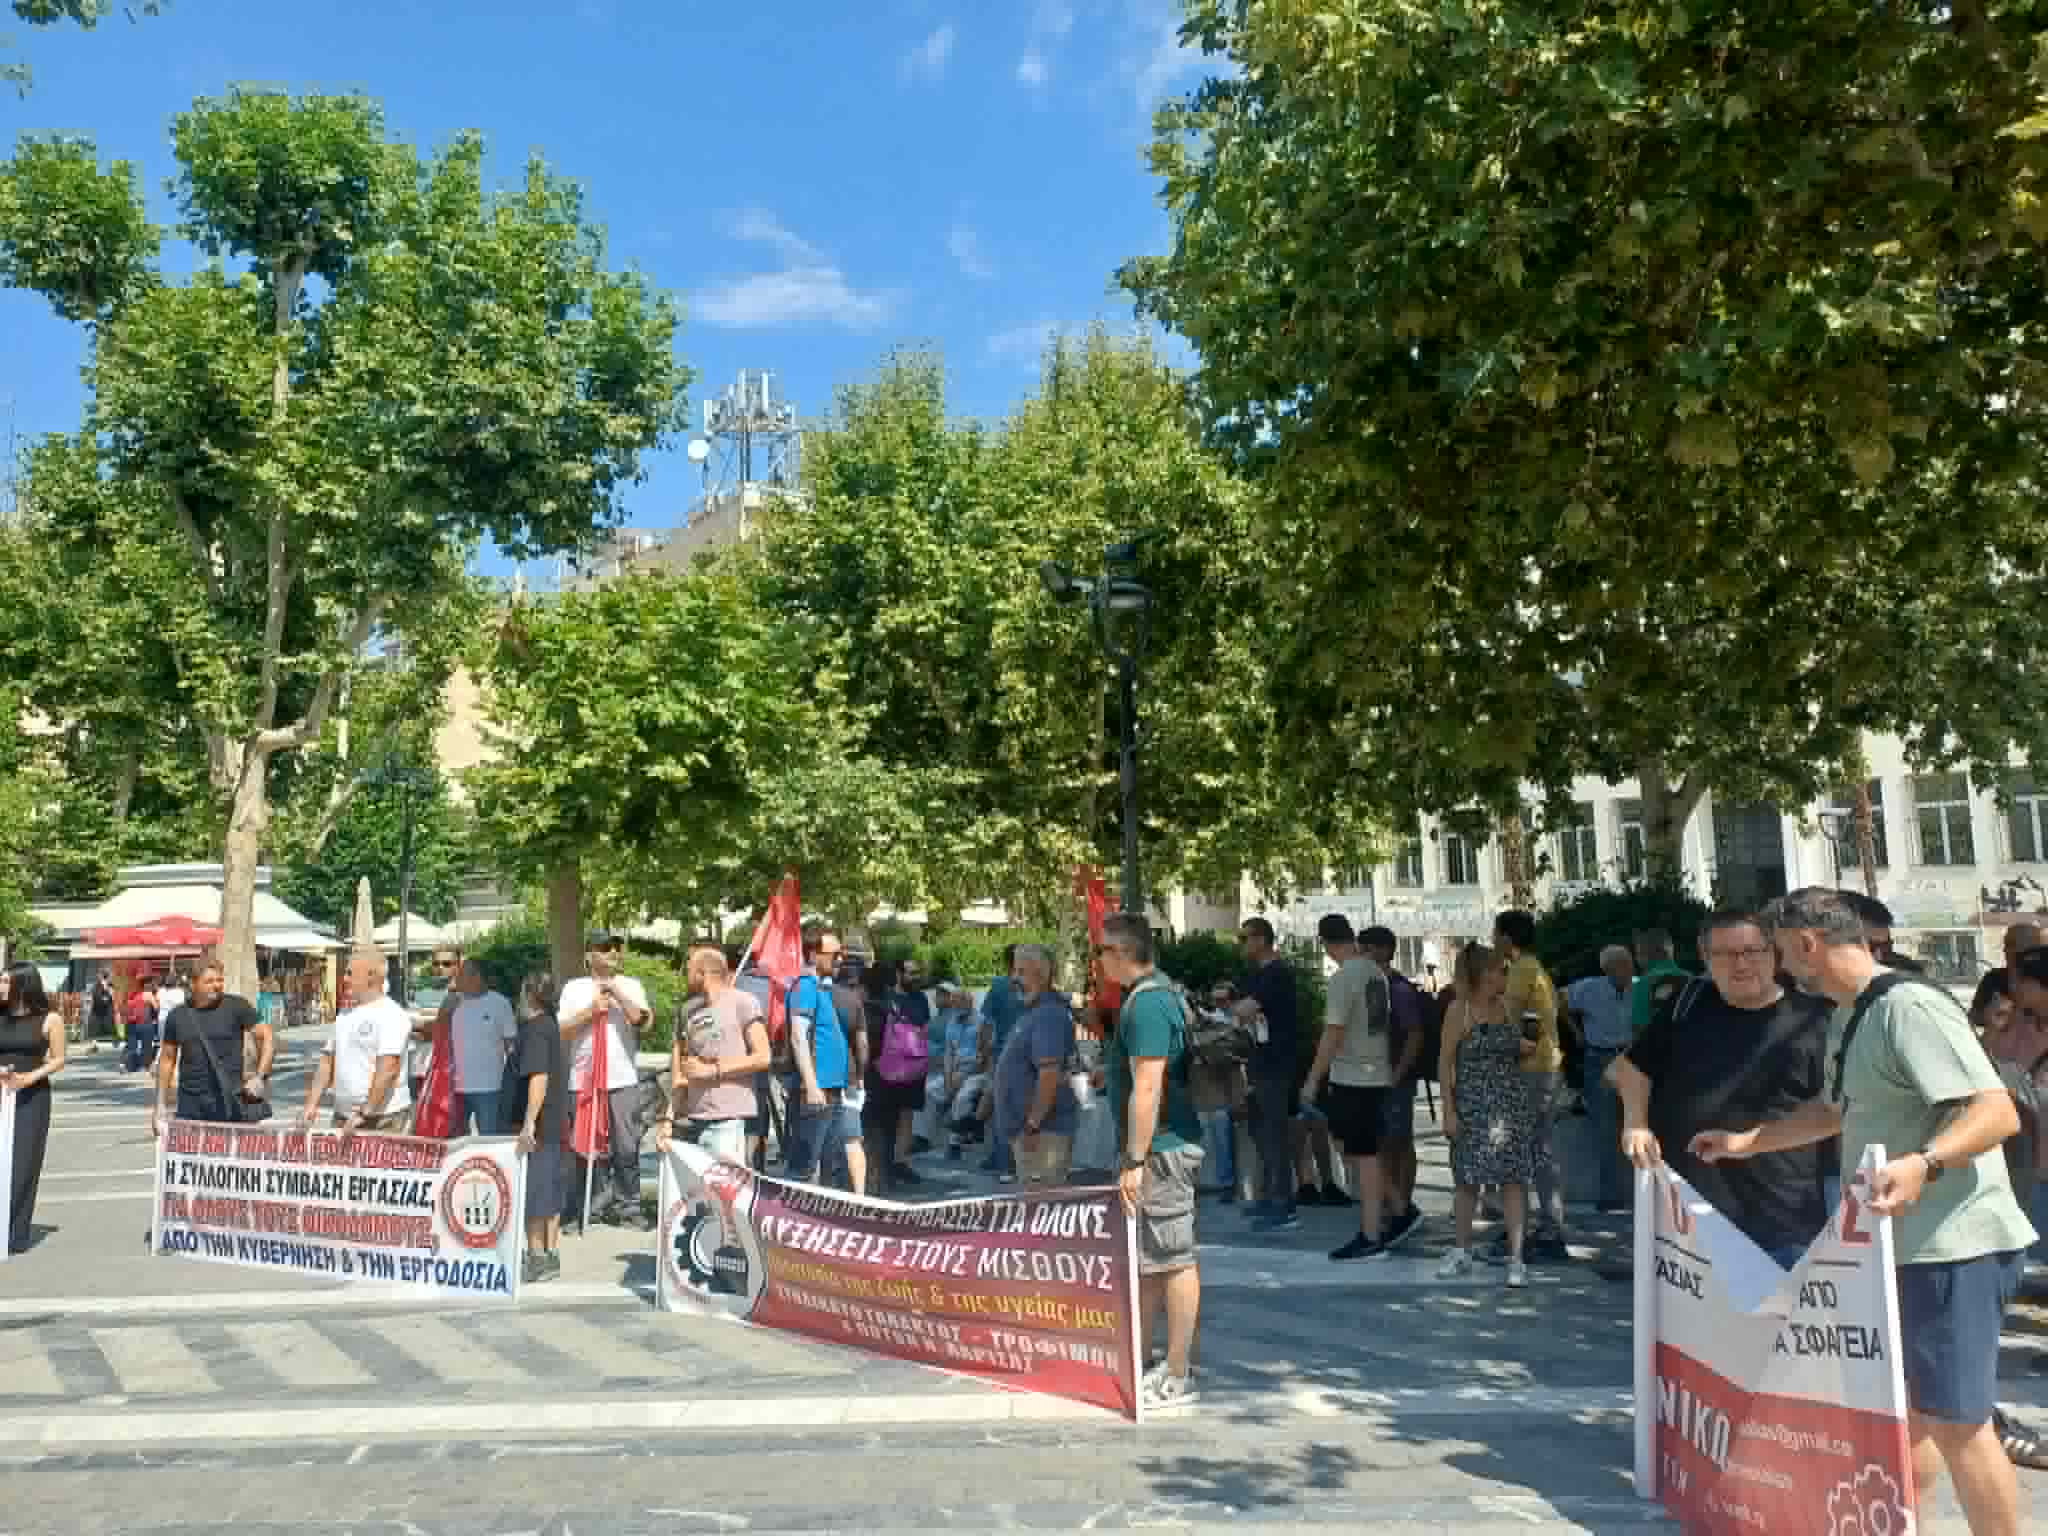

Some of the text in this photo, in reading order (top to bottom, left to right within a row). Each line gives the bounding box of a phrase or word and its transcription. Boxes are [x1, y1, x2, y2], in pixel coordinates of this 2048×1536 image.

[166, 1160, 176, 1184] Η
[179, 1162, 262, 1192] ΣΥΛΛΟΓΙΚΗ
[265, 1170, 344, 1201] ΣΥΜΒΑΣΗ
[989, 1201, 1027, 1233] ΓΙΑ
[1031, 1202, 1113, 1240] ΟΛΟΥΣ
[163, 1228, 507, 1291] ΑΠΟ ΤΗΝ ΚΥΒΕΡΝΗΣΗ & ΤΗΝ ΕΡΓΟΔΟΣΙΑ
[761, 1215, 894, 1264] ΑΥΞΗΣΕΙΣ
[893, 1238, 975, 1276] ΣΤΟΥΣ
[976, 1246, 1113, 1290] ΜΙΣΘΟΥΣ
[929, 1283, 945, 1305] &
[950, 1292, 990, 1316] της
[994, 1292, 1070, 1328] υγείας
[1074, 1303, 1119, 1337] μας
[1799, 1279, 1838, 1309] ΑΠΟ
[990, 1328, 1120, 1374] ΤΡΟΦΙΜΩΝ
